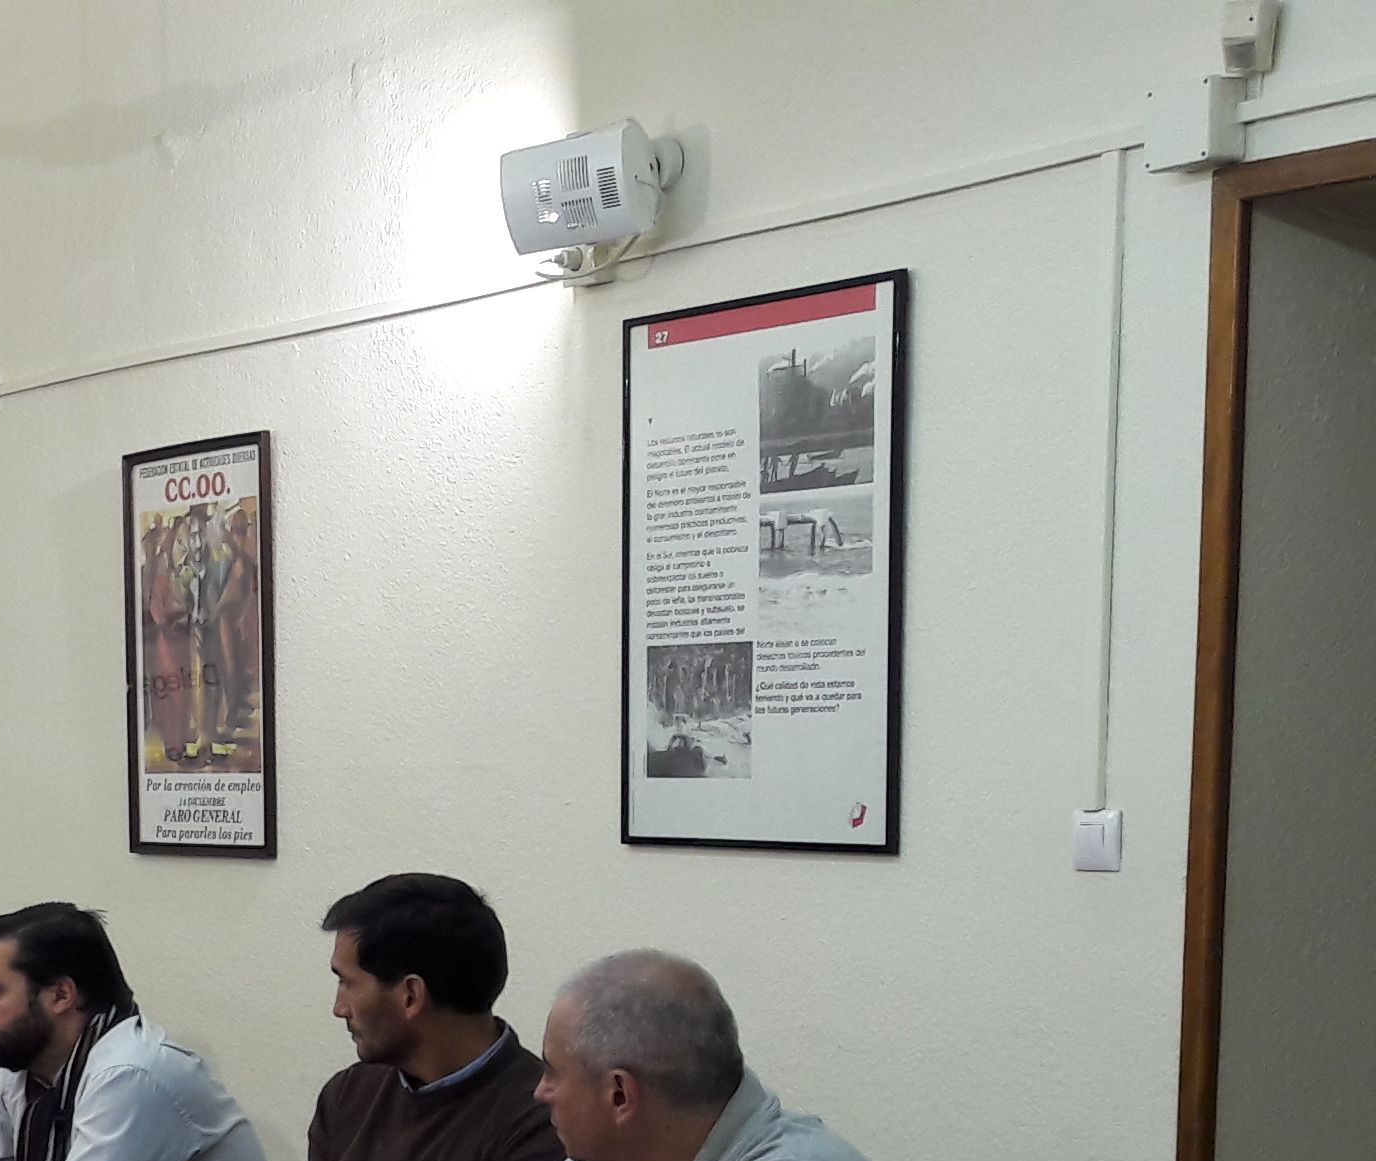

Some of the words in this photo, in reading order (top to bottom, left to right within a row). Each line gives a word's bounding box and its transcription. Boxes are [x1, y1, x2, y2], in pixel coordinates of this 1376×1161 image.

[655, 331, 669, 344] 27
[165, 471, 231, 502] CC.OO.
[146, 779, 162, 791] Por
[164, 778, 172, 791] la
[214, 778, 225, 791] de
[227, 778, 261, 794] empleo
[164, 809, 192, 823] PARO
[192, 809, 242, 824] GENERAL
[156, 825, 177, 839] Para
[218, 826, 232, 839] los
[233, 827, 253, 843] pies
